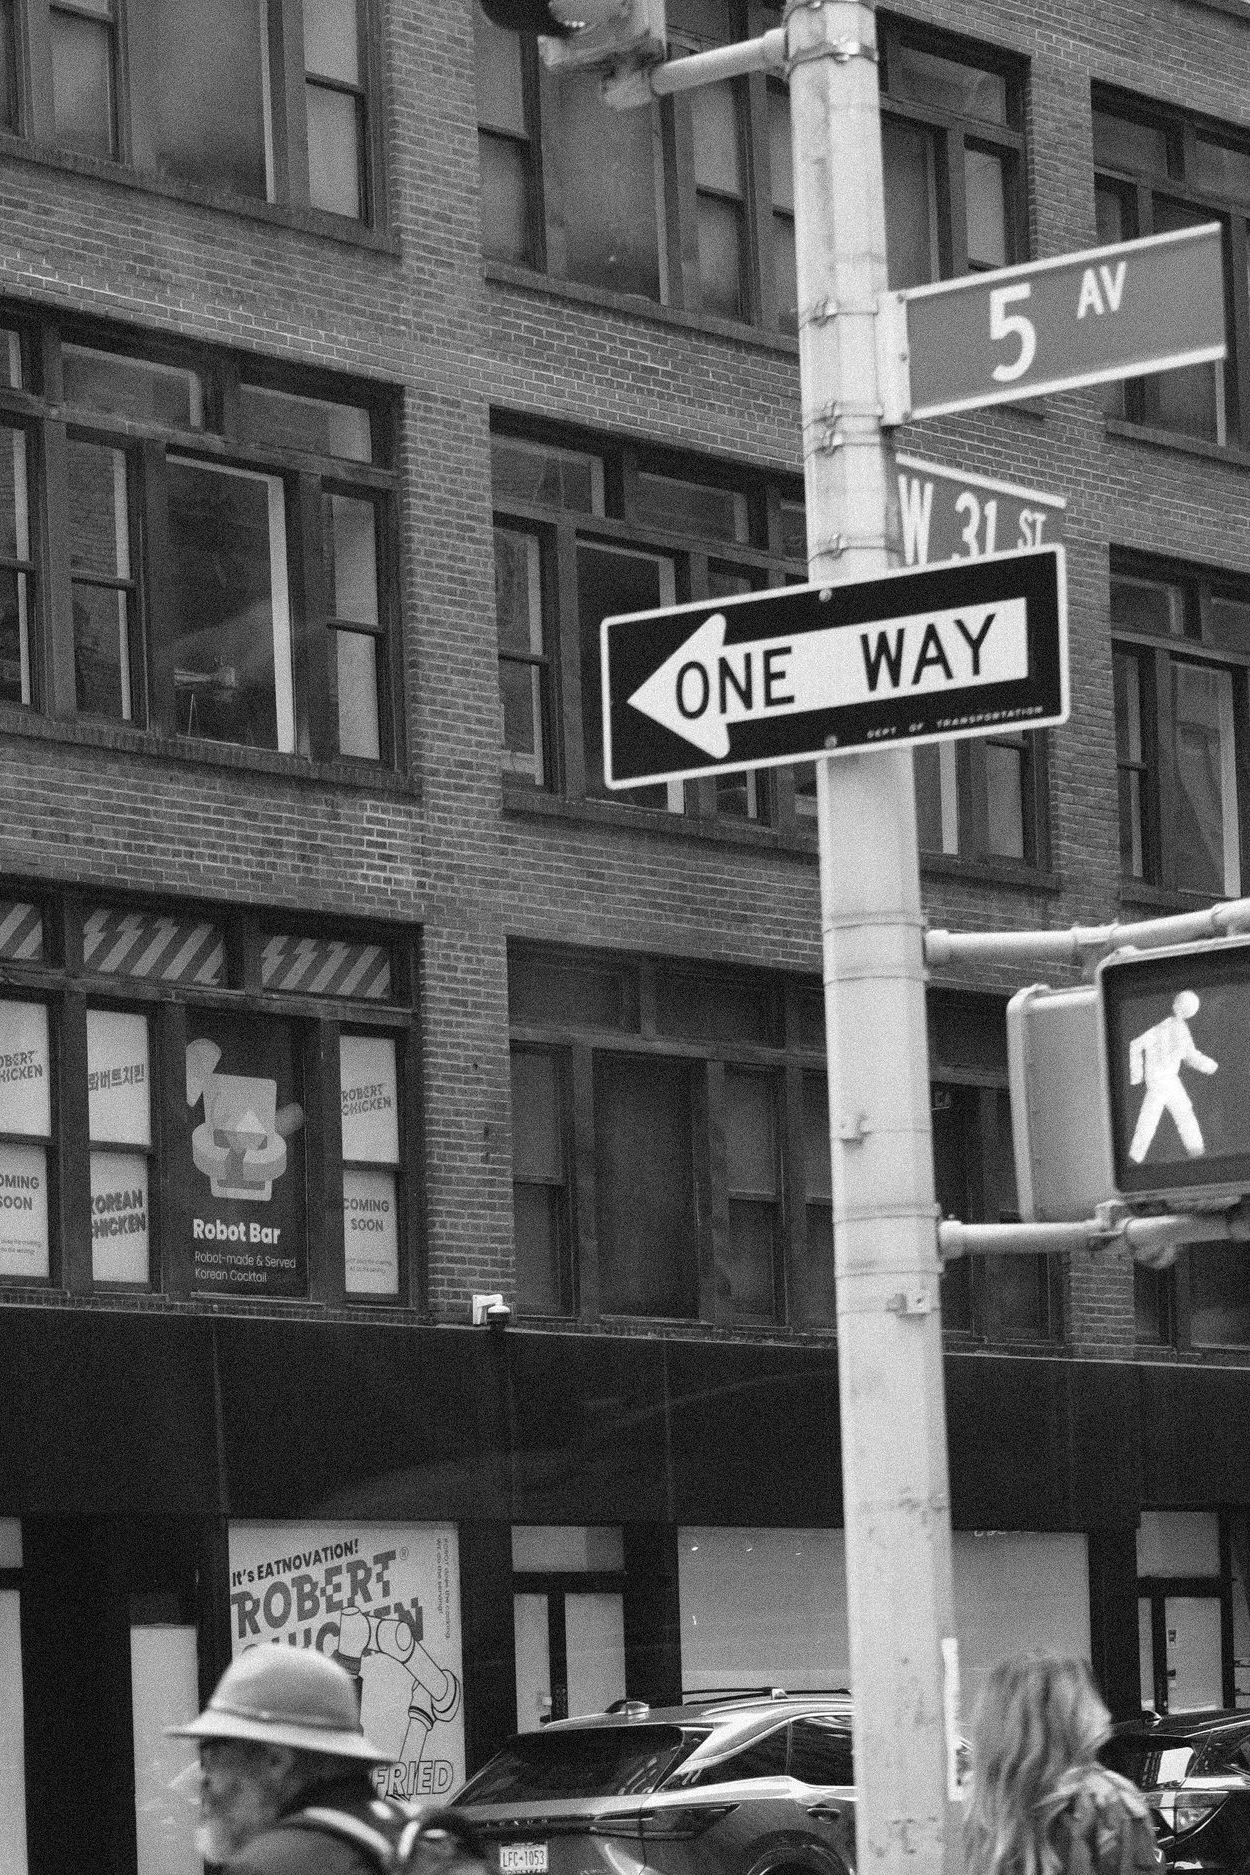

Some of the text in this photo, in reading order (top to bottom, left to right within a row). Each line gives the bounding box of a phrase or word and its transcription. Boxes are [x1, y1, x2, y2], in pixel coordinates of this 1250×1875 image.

[989, 261, 1127, 382] 5 AV
[898, 474, 1047, 566] W 31 ST
[675, 613, 997, 720] ONE WAY
[867, 705, 1044, 739] DEPT OF TRANSPORTATION
[341, 1082, 385, 1104] ROBERT
[341, 1096, 392, 1118] CHICKEN
[193, 1218, 281, 1244] Robot Bar
[350, 1217, 384, 1232] SOON
[194, 1250, 297, 1269] Robot-made & Served
[195, 1267, 268, 1283] Korean Cocktail
[231, 1538, 360, 1587] It's EATNOVATION!
[230, 1550, 397, 1640] ROBERT
[371, 1759, 454, 1799] FRIED
